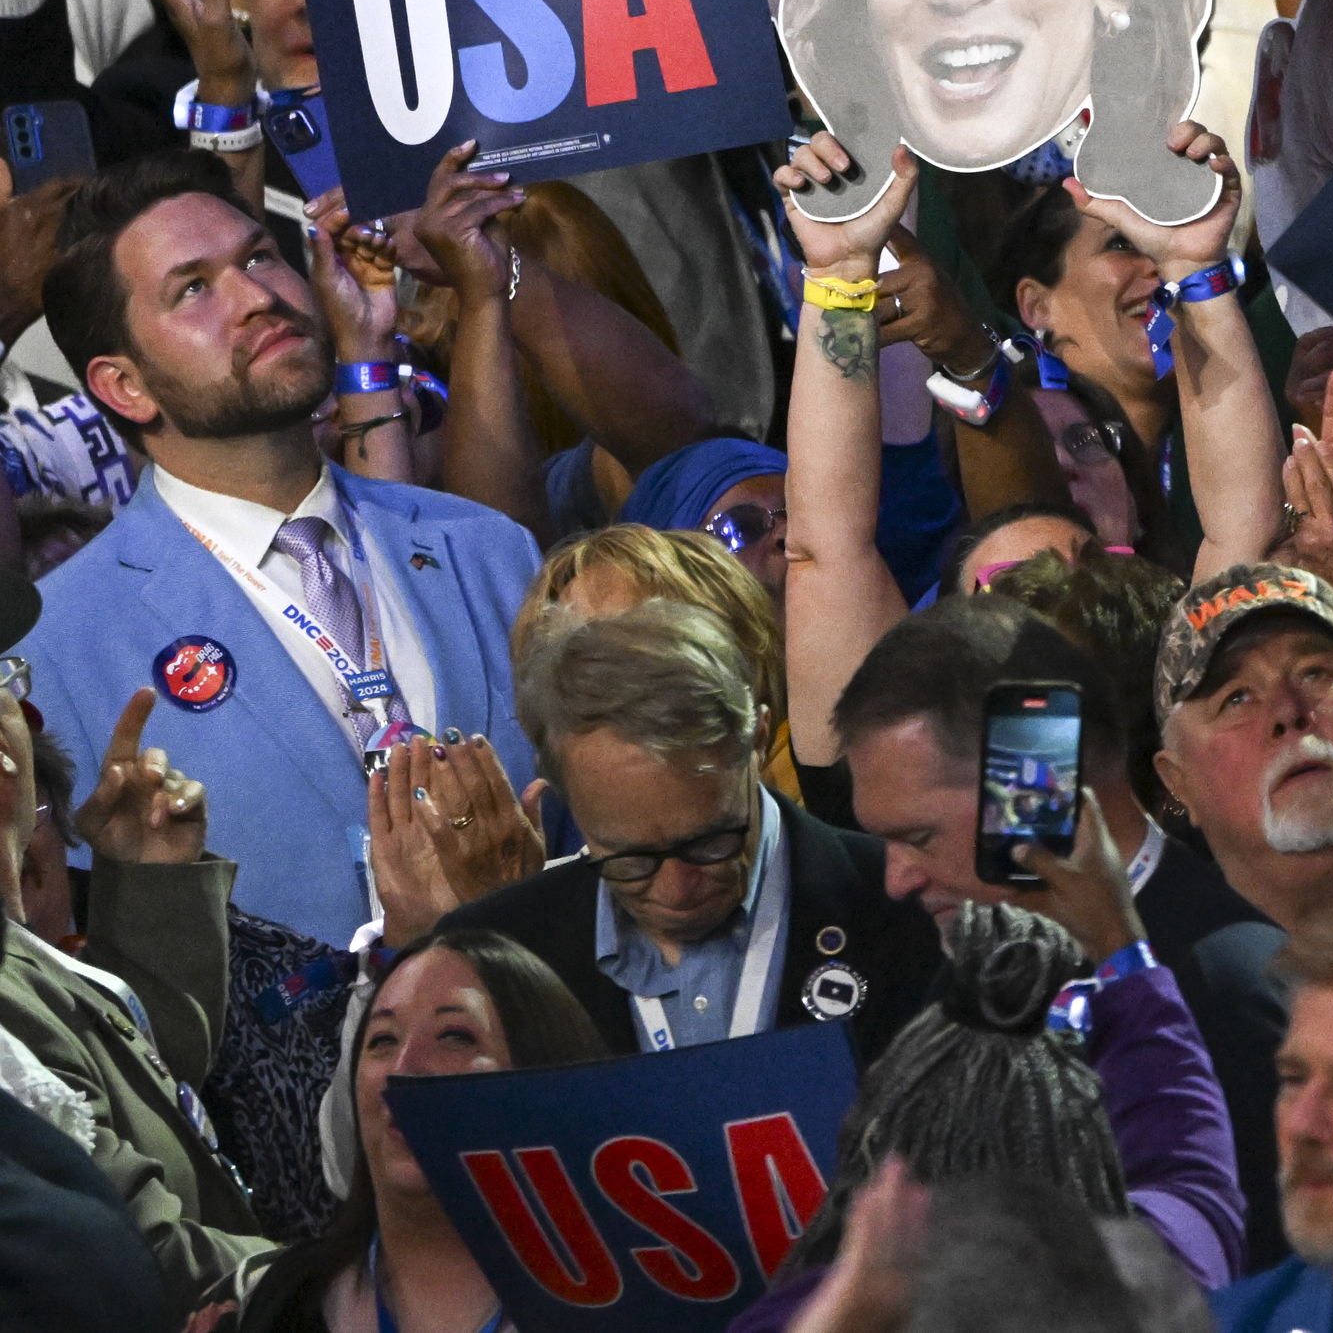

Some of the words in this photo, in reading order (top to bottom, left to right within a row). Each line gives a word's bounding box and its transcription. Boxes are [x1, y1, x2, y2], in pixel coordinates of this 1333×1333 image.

[1188, 580, 1315, 631] WALZ
[282, 604, 322, 640] DNC
[195, 642, 215, 663] DRAG
[208, 648, 223, 664] PAC
[349, 672, 386, 686] HARRIS
[357, 684, 388, 696] 2024
[458, 1111, 829, 1308] USA
